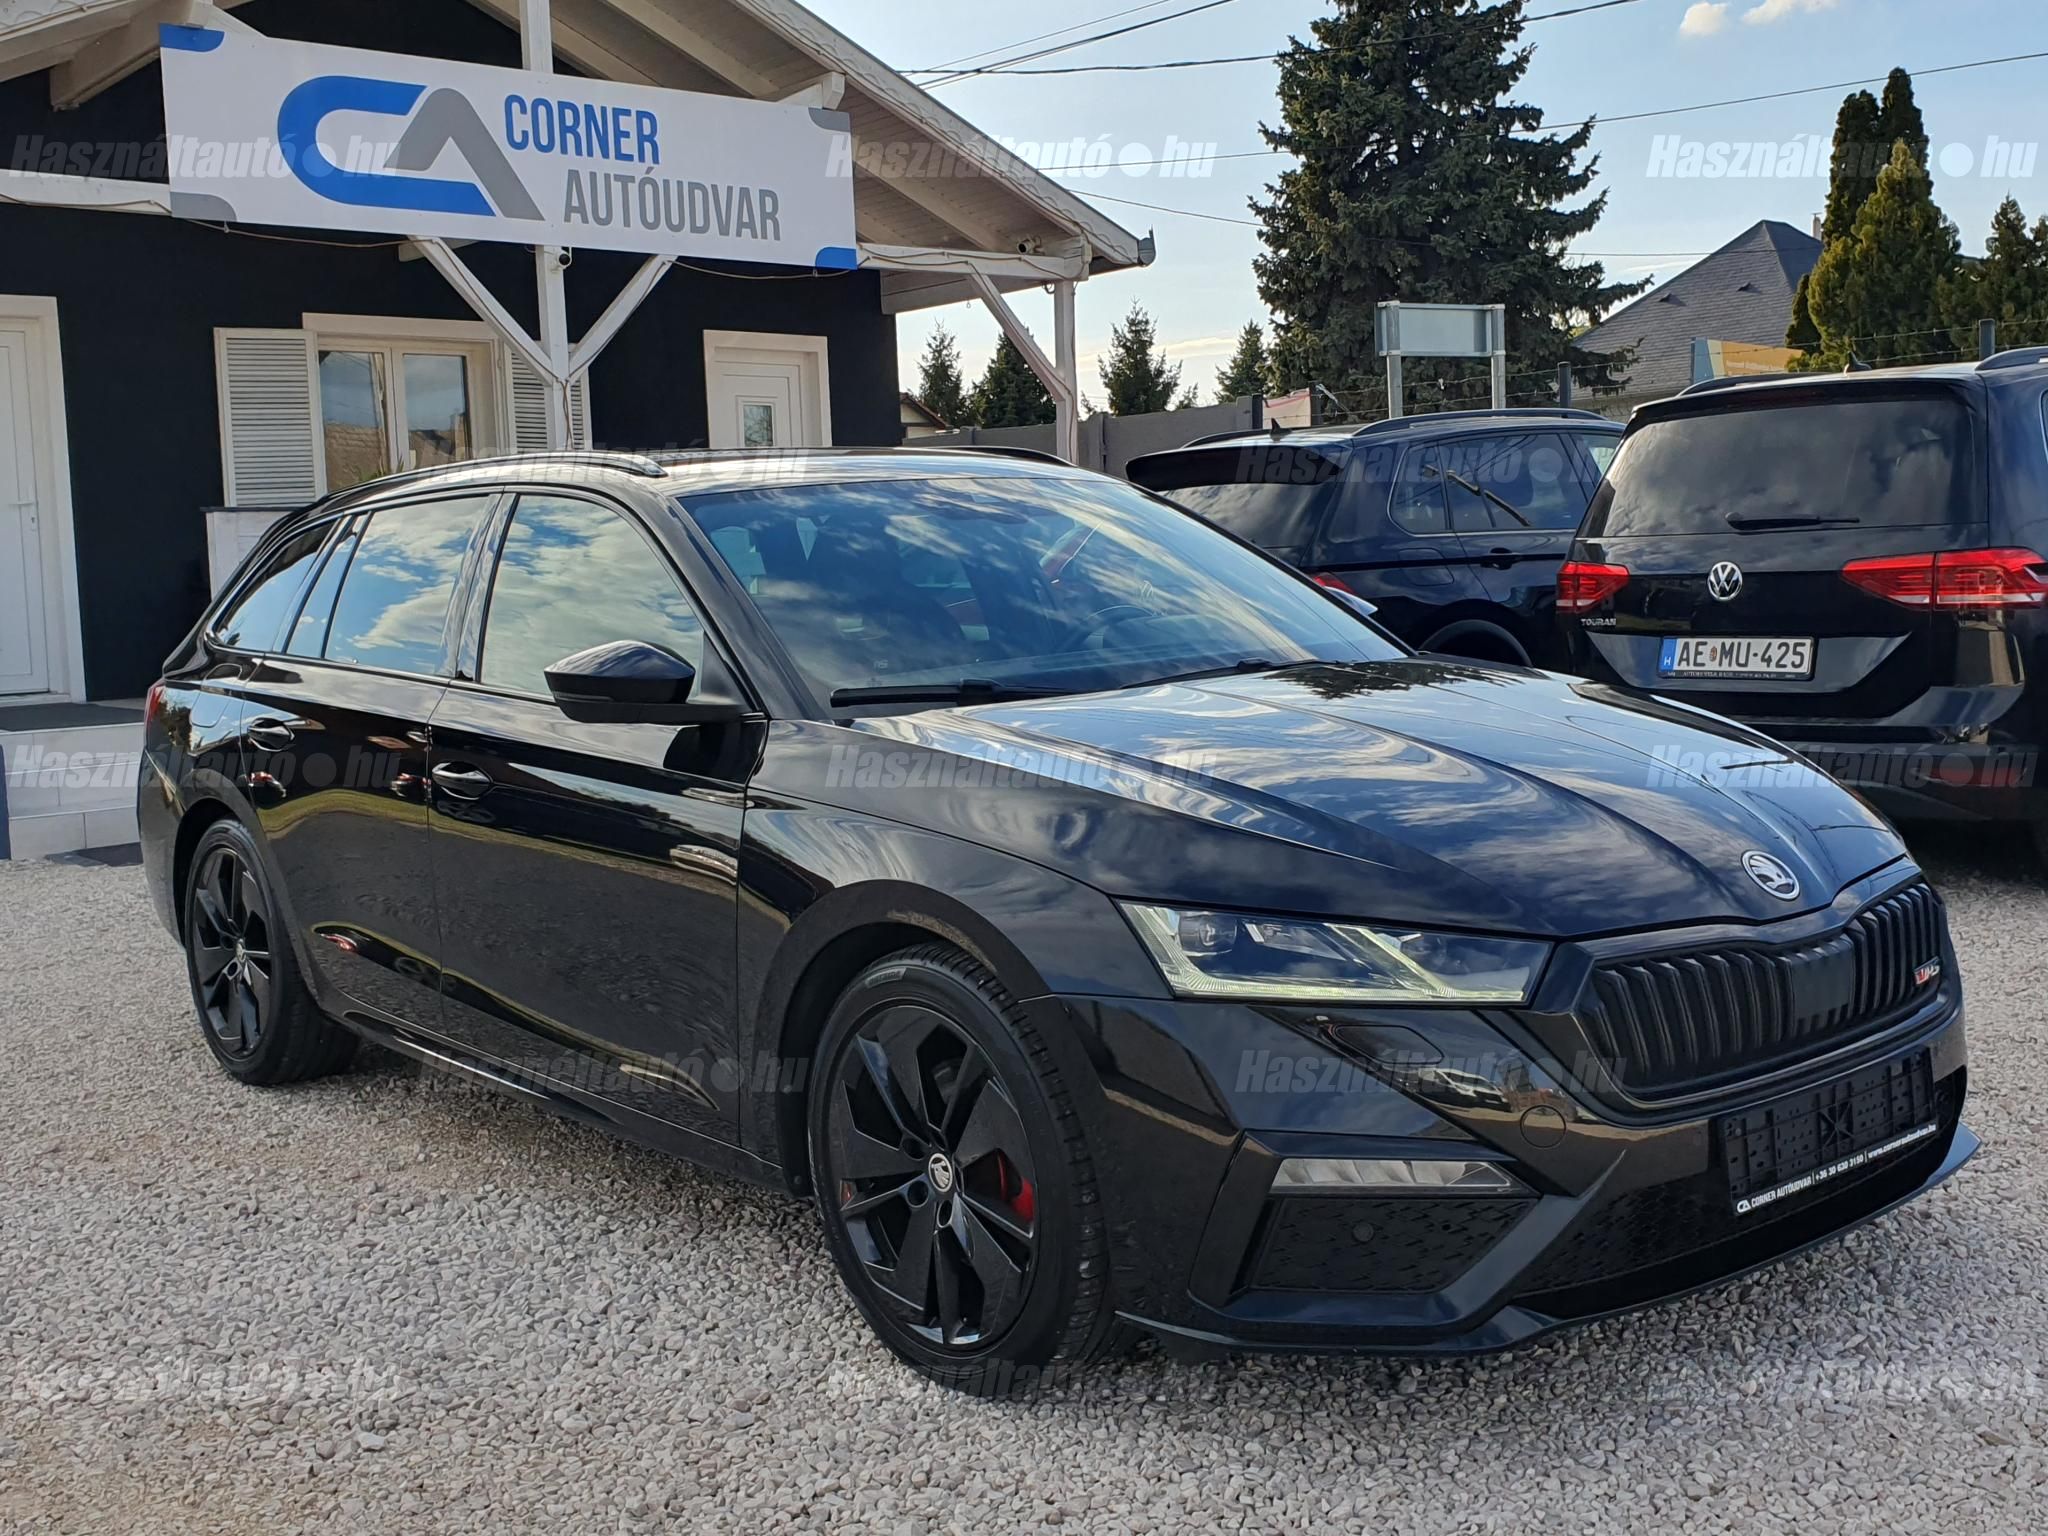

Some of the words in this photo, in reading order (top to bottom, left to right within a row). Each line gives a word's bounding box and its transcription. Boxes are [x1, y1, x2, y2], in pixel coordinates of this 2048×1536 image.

[503, 93, 661, 165] CORNER
[563, 166, 782, 241] AUTÓUDVAR
[1580, 617, 1617, 627] TOURAN
[1663, 656, 1672, 667] H
[1677, 640, 1708, 668] AE
[1717, 641, 1807, 670] MU-425
[1751, 1190, 1776, 1208] CORNER
[1776, 1175, 1811, 1199] AUTÓUDVAR
[1815, 1169, 1828, 1181] +36
[1828, 1165, 1837, 1176] 30
